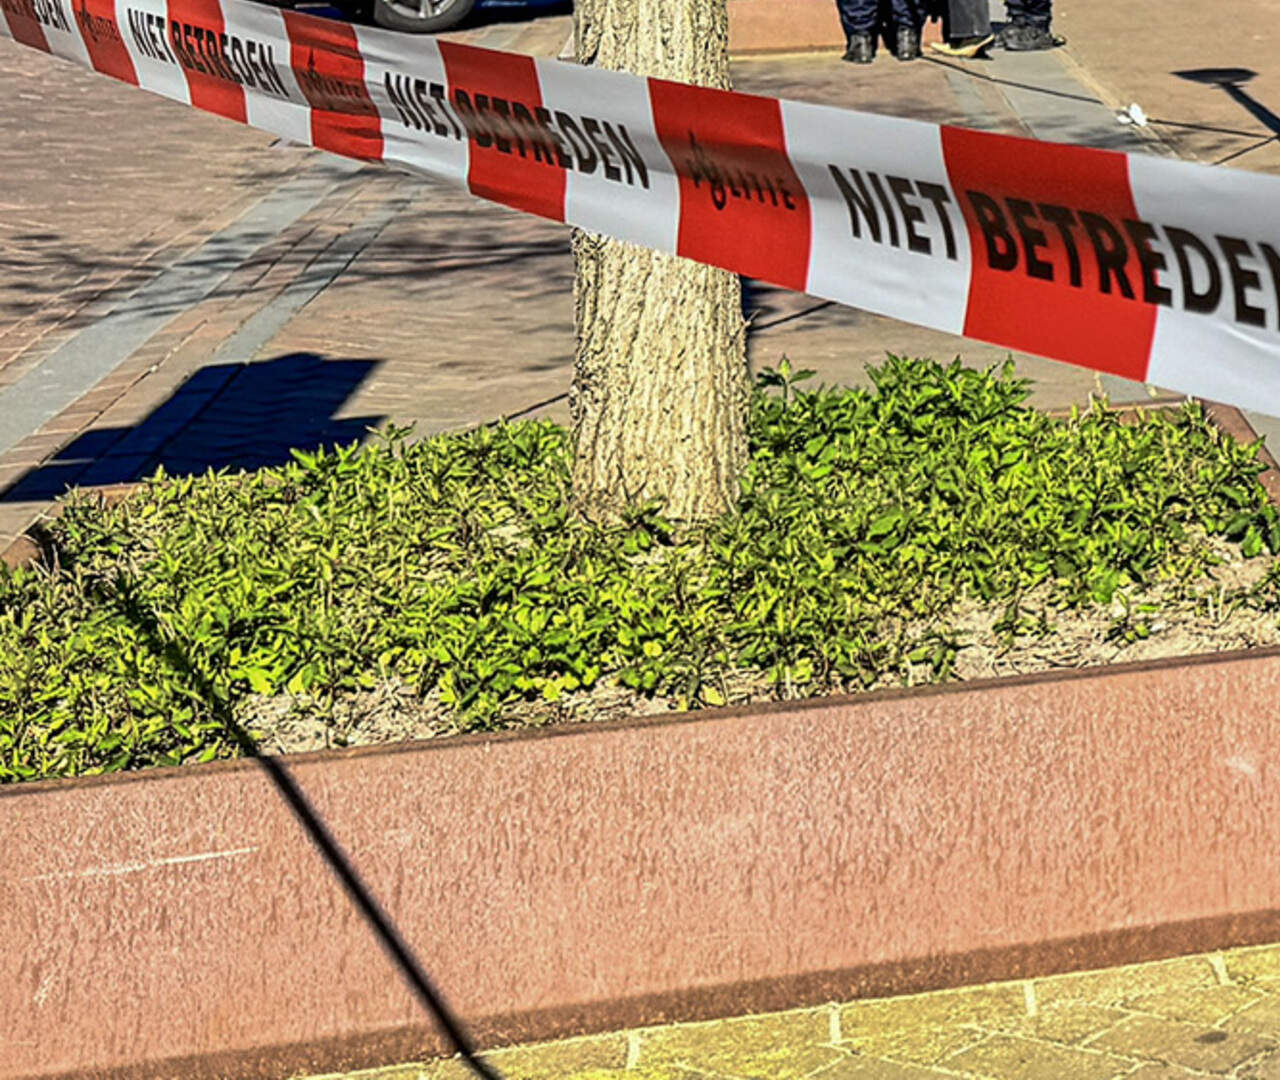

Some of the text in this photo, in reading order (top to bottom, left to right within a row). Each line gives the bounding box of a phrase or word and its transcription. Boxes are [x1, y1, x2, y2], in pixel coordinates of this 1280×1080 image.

[127, 8, 177, 65] NIET
[171, 20, 290, 98] BETREDEN
[383, 72, 467, 142] NIET
[452, 88, 650, 189] BETREDEN
[828, 165, 960, 261] NIET
